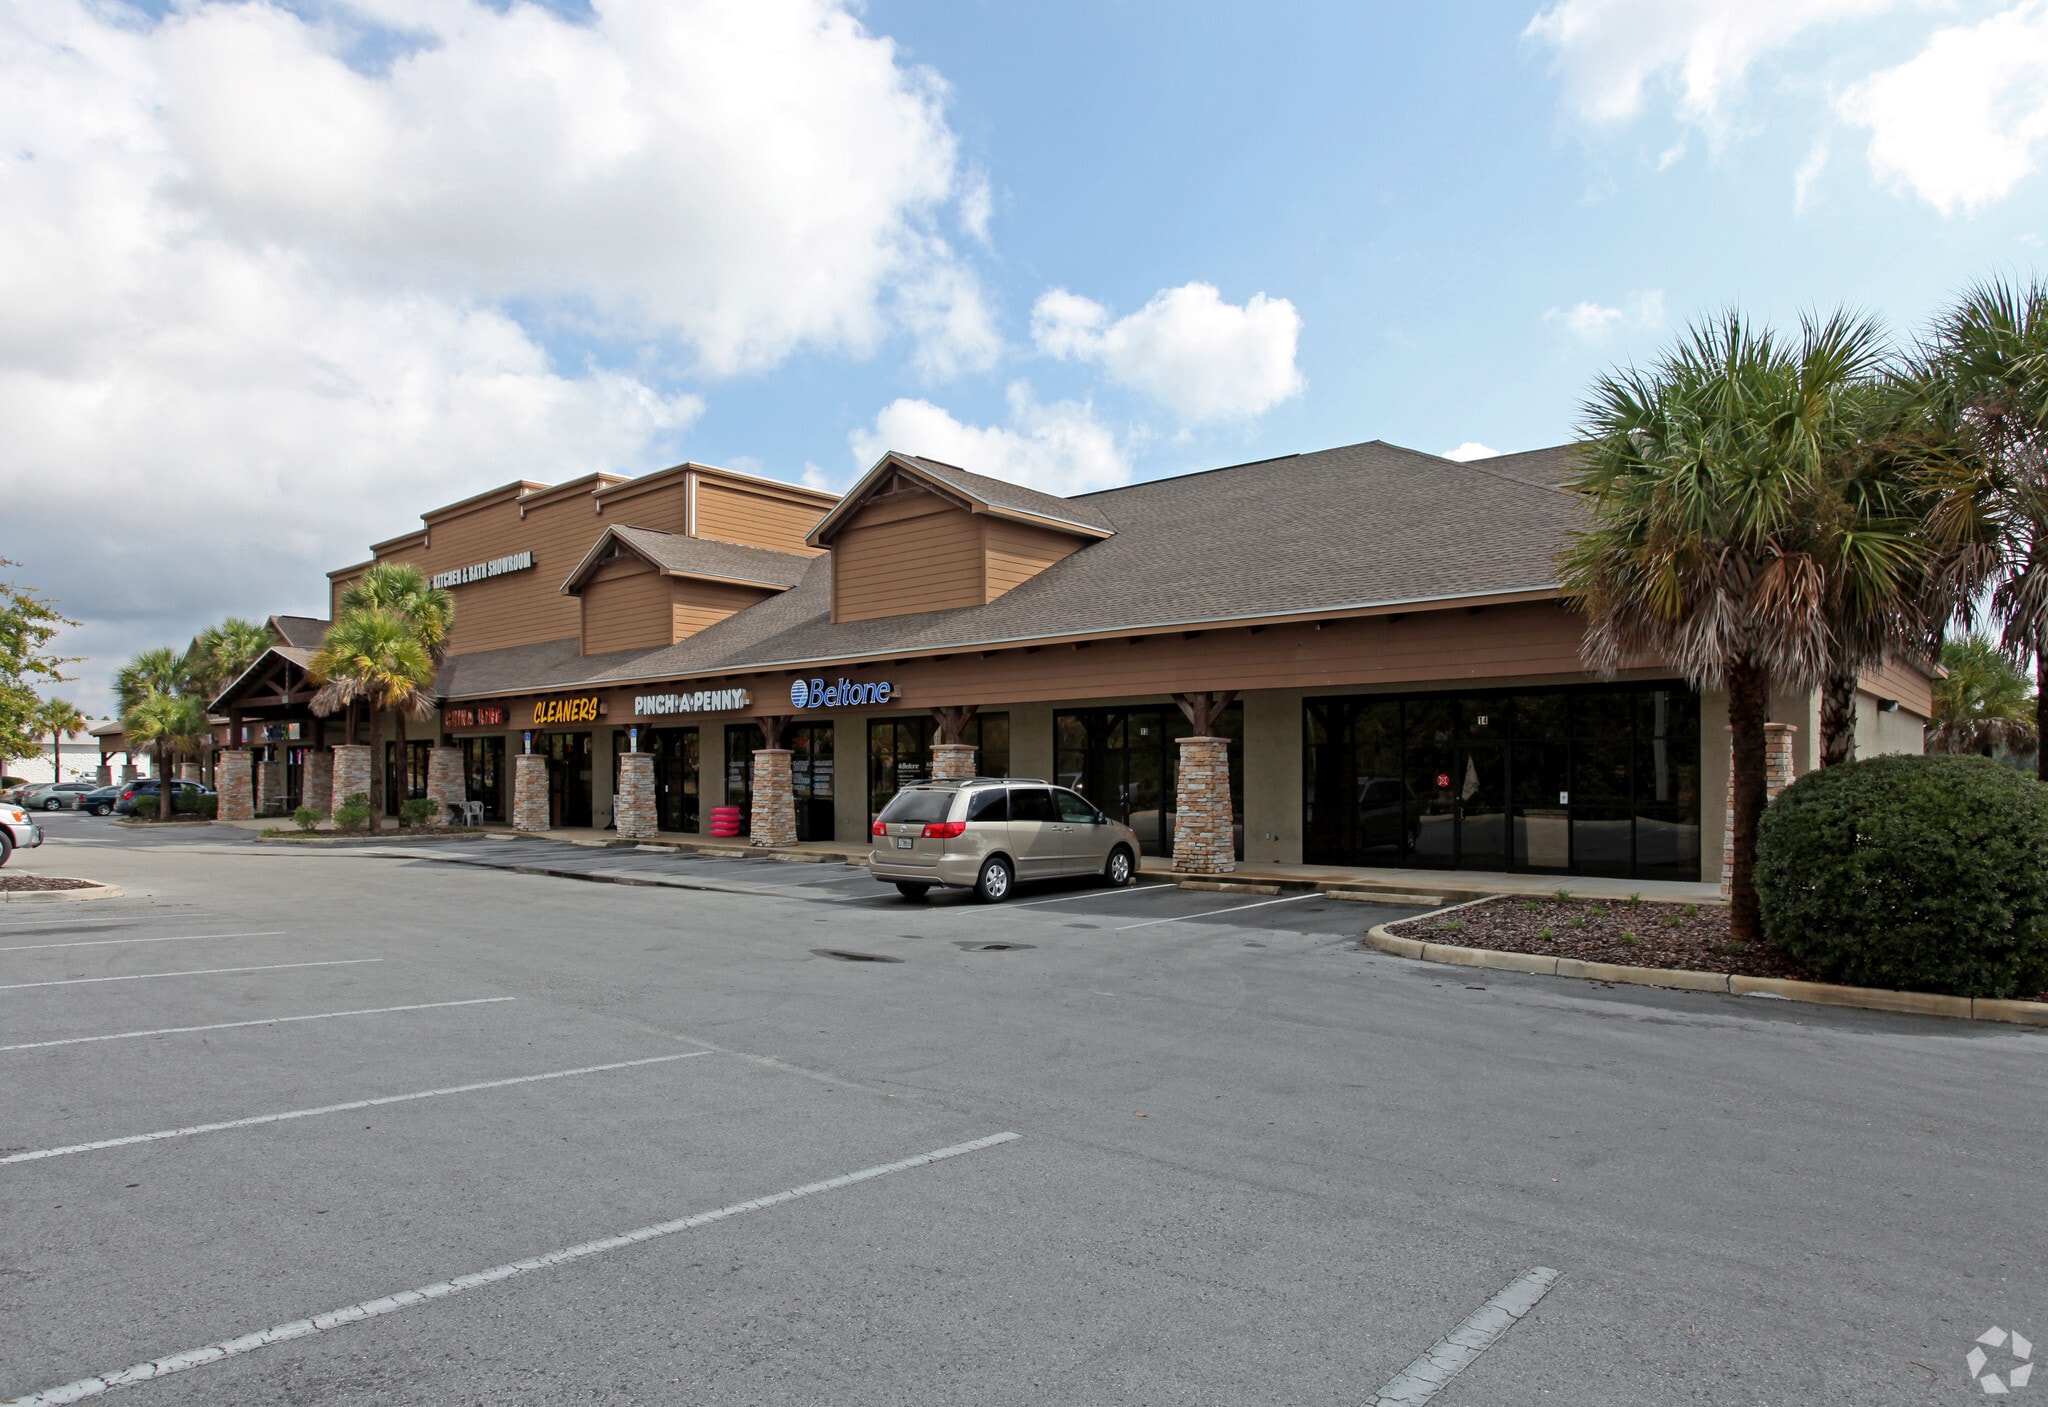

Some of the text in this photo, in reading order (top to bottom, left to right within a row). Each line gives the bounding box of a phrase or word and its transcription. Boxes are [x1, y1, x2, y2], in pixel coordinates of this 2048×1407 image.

[433, 569, 462, 589] KITCHEN
[462, 567, 469, 583] &
[468, 562, 487, 582] BATH
[488, 551, 532, 577] SHOWROOM
[808, 678, 891, 708] Beltone
[533, 697, 598, 724] CLEANERS
